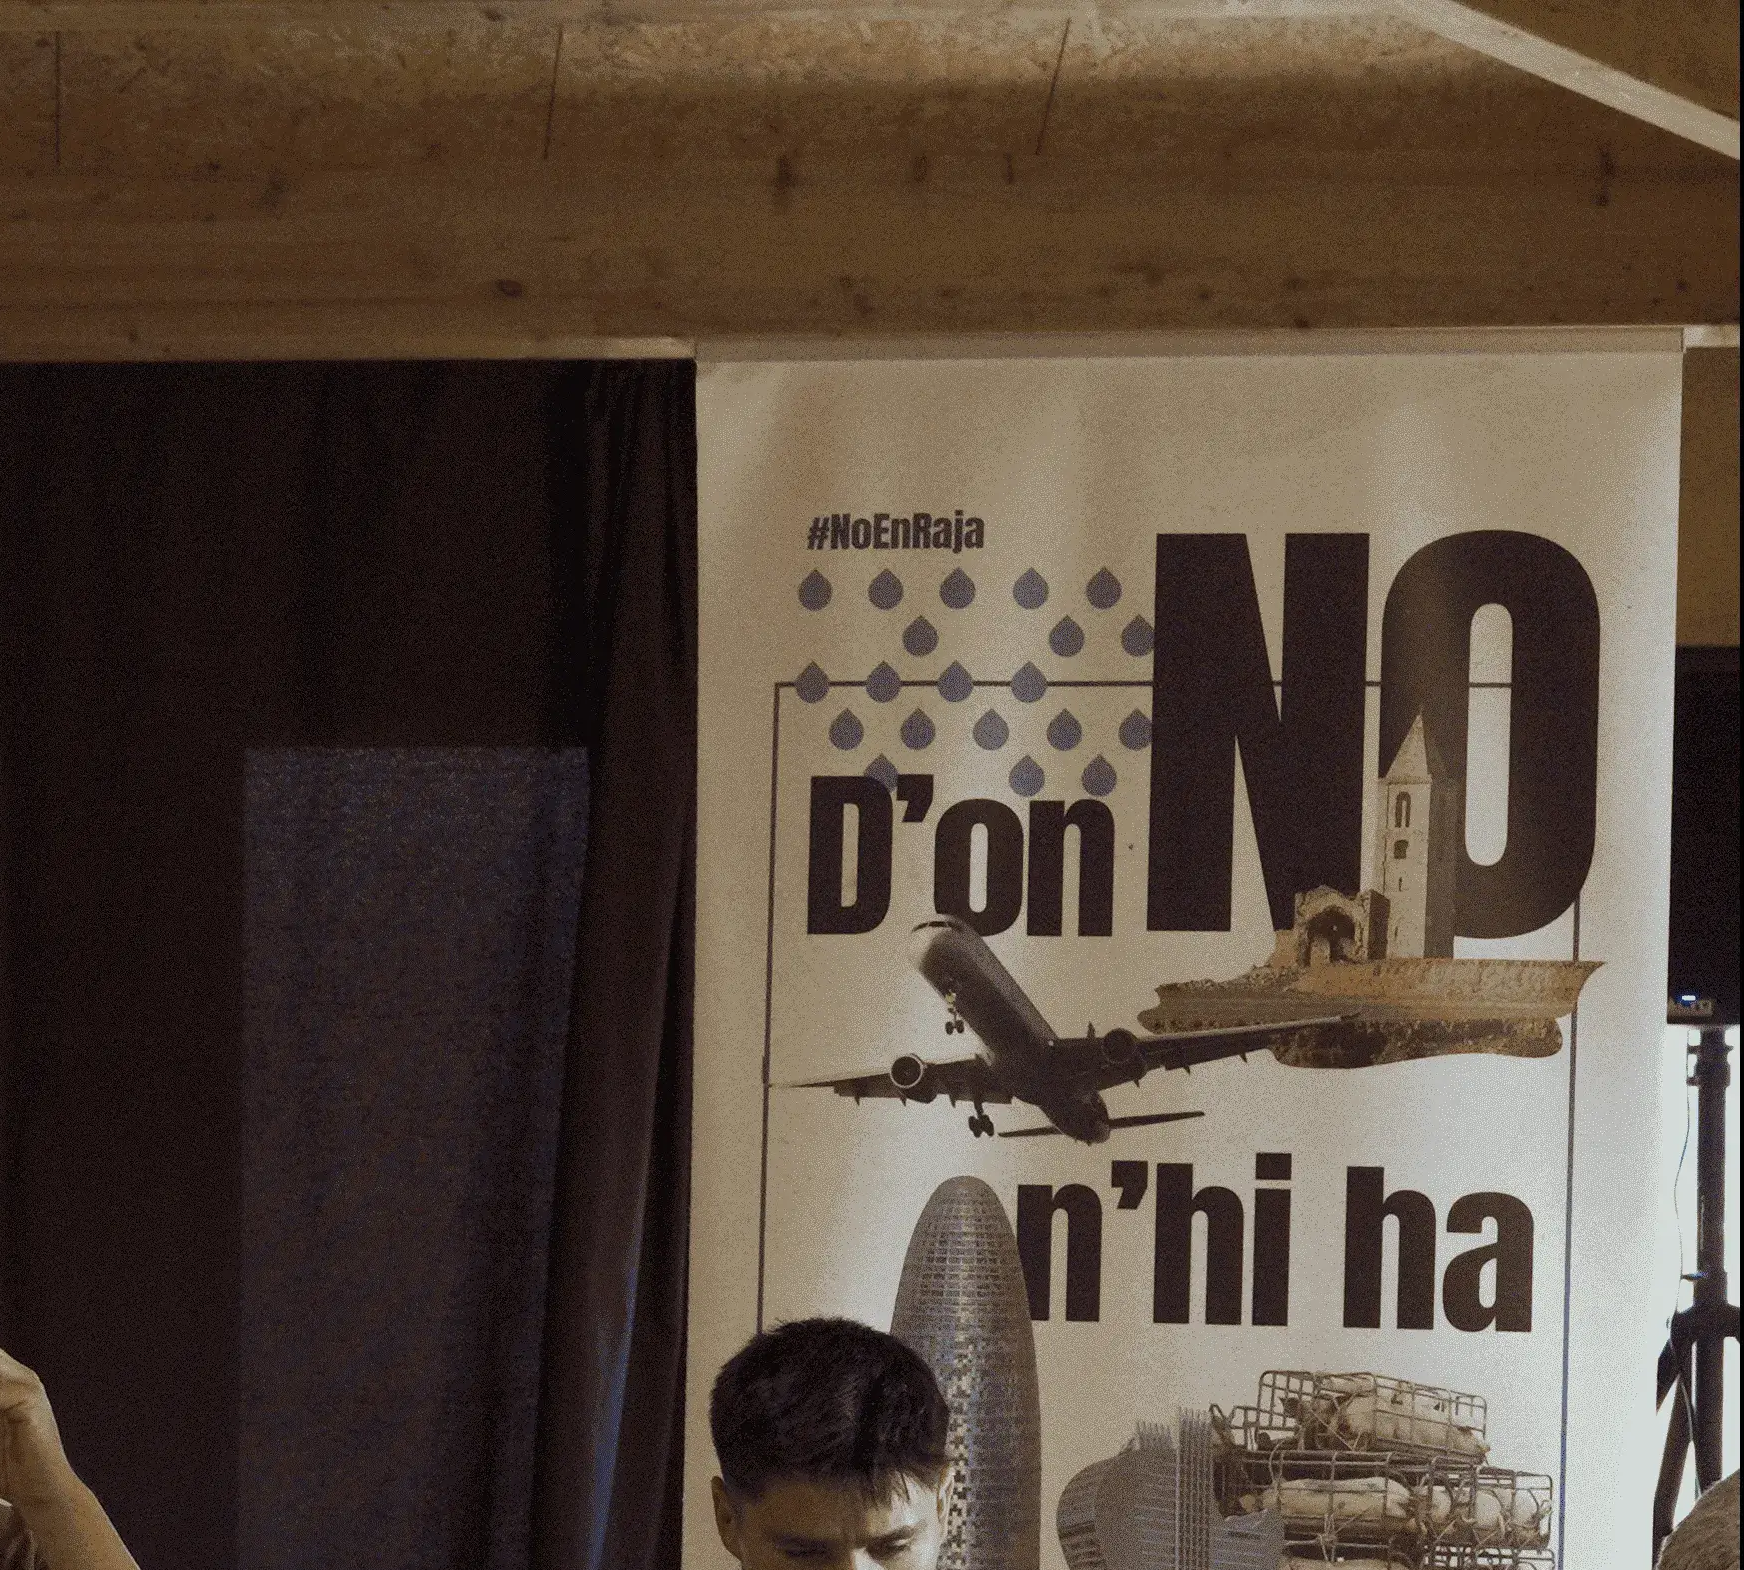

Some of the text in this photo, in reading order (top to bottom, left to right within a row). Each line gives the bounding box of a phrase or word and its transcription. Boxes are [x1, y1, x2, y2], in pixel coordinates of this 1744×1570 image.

[807, 511, 985, 555] #NoEnRaja
[807, 529, 1601, 939] D'on NO
[1016, 1151, 1535, 1333] n'hi ha
